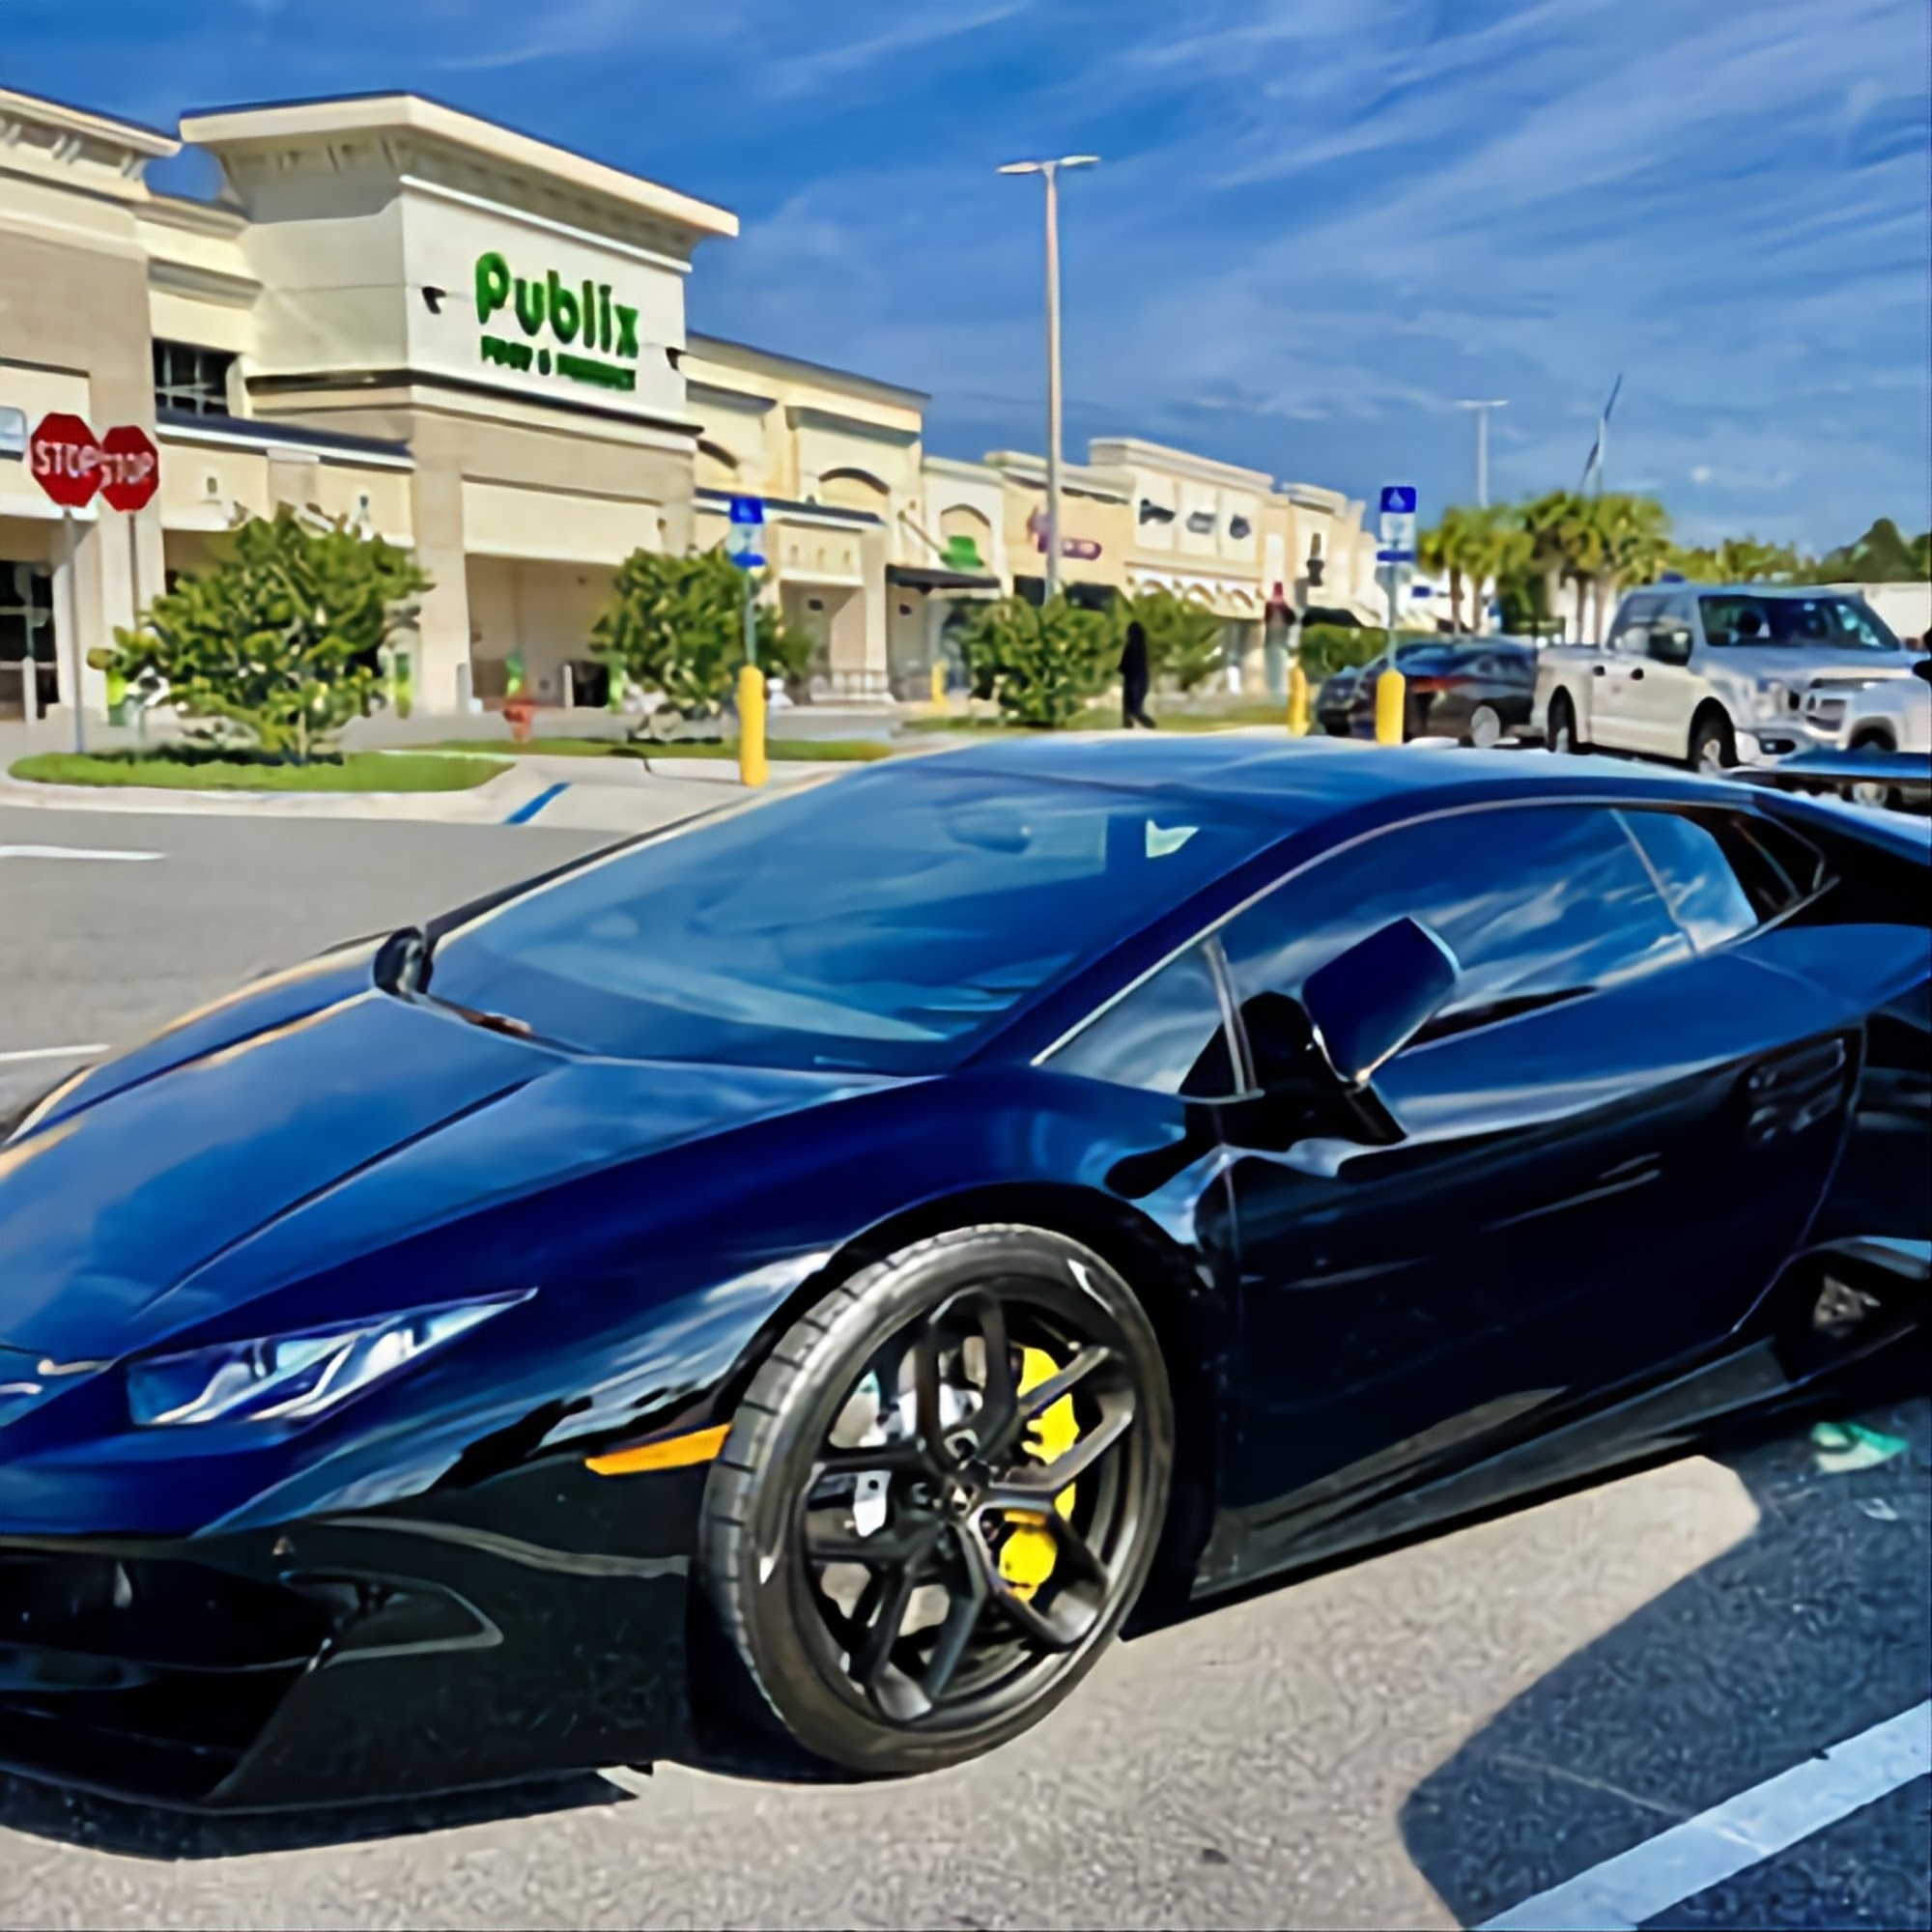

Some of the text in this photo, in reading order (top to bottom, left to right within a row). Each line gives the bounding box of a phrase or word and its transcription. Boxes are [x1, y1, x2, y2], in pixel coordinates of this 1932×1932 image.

[476, 251, 639, 358] Publix
[35, 440, 99, 478] STOP
[99, 451, 155, 487] STOP
